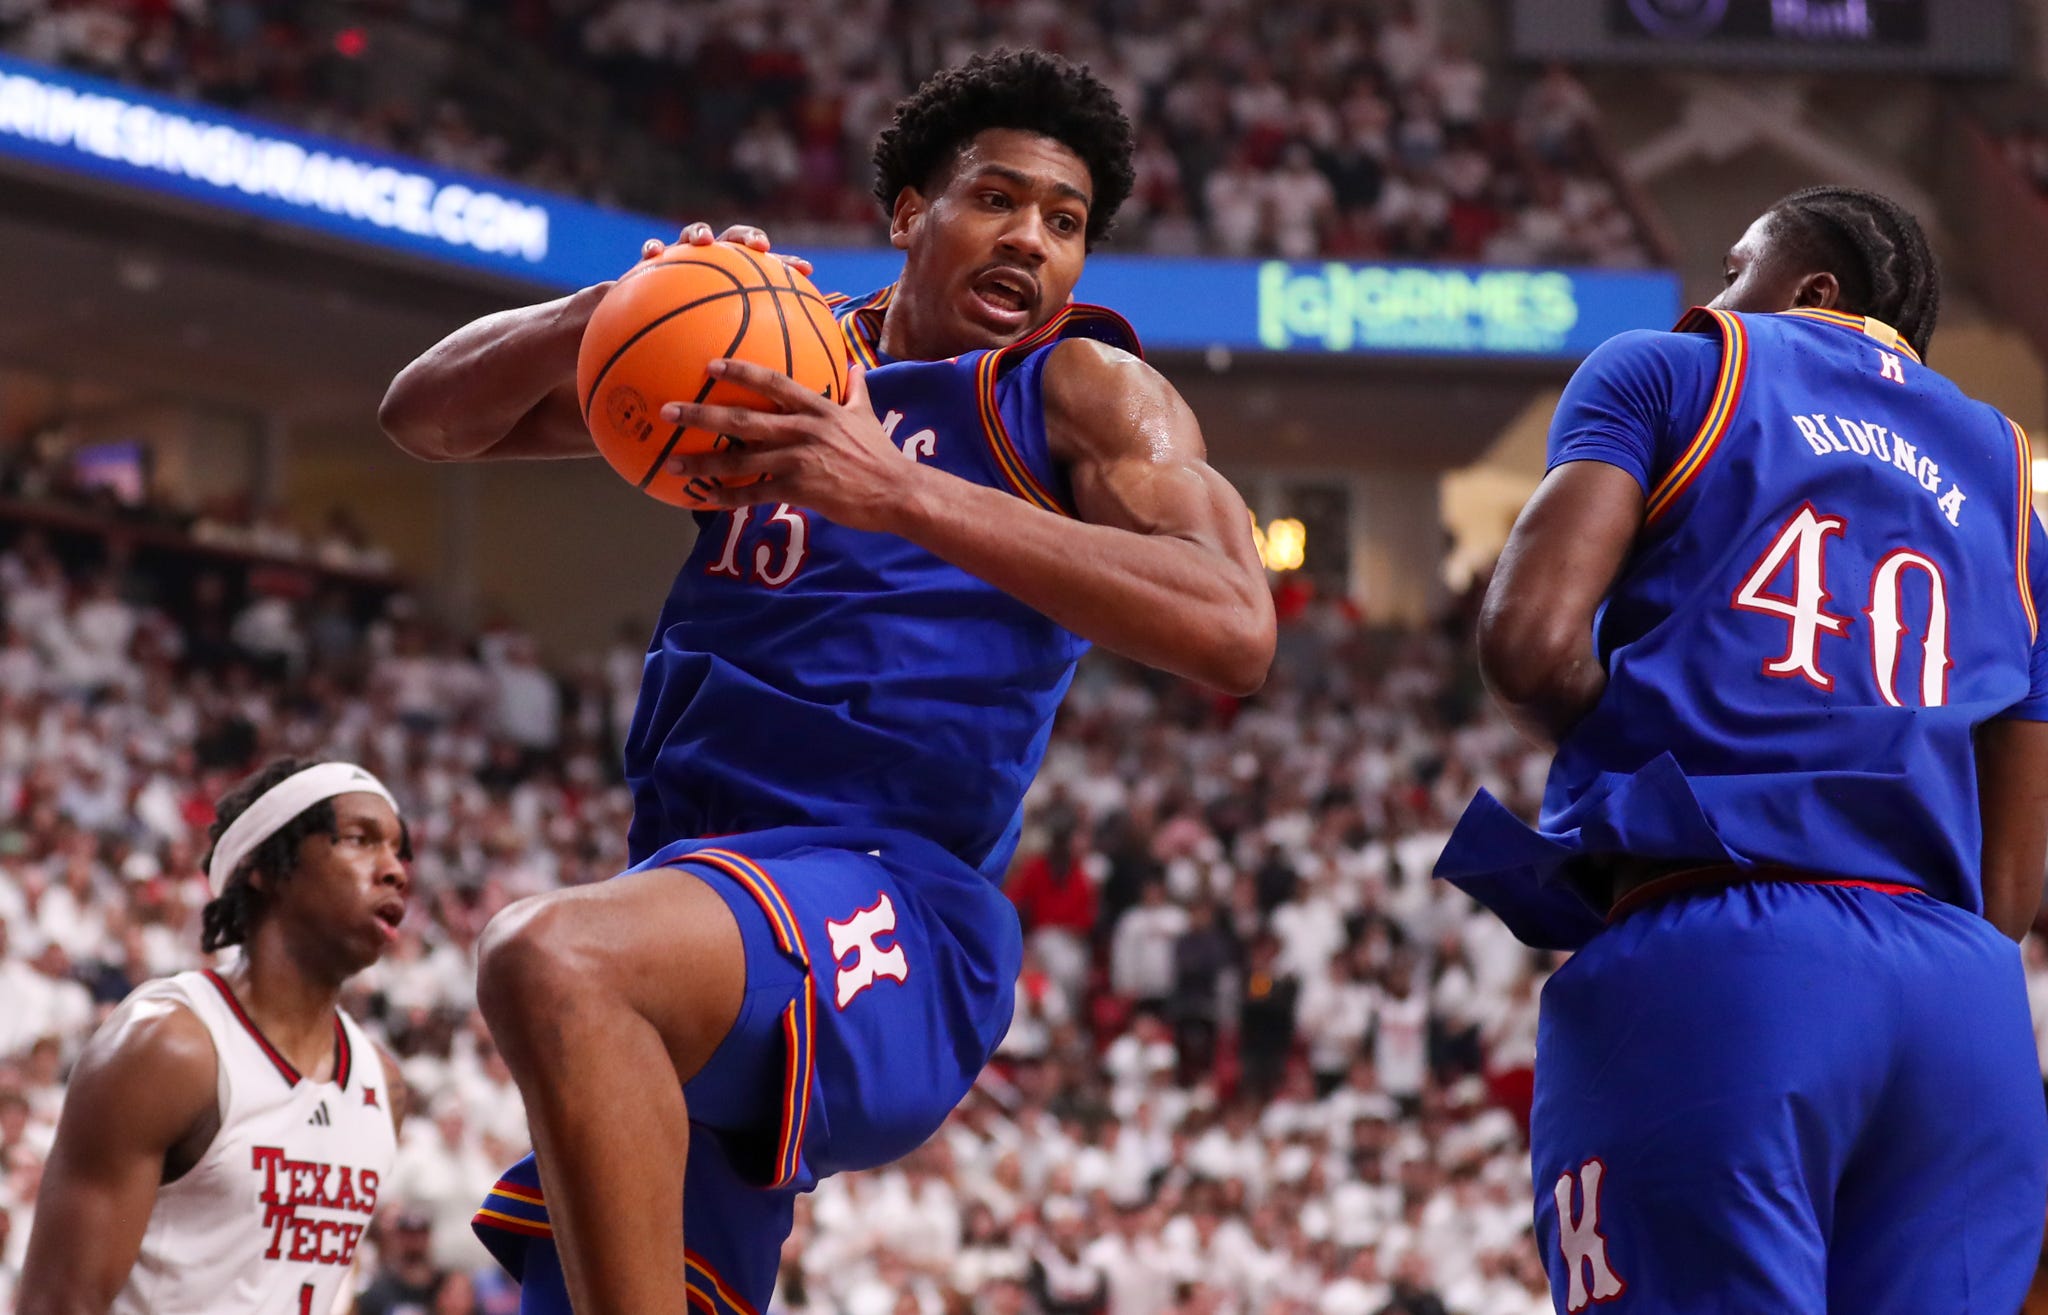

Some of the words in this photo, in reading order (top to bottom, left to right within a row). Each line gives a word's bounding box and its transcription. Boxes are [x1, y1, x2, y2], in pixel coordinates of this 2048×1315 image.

[1876, 349, 1905, 383] K
[1793, 415, 1966, 526] BIDUNGA
[1732, 501, 1954, 706] 40
[825, 890, 910, 1012] K
[252, 1146, 378, 1214] TEXAS
[263, 1204, 364, 1265] TECH
[1554, 1157, 1628, 1314] K
